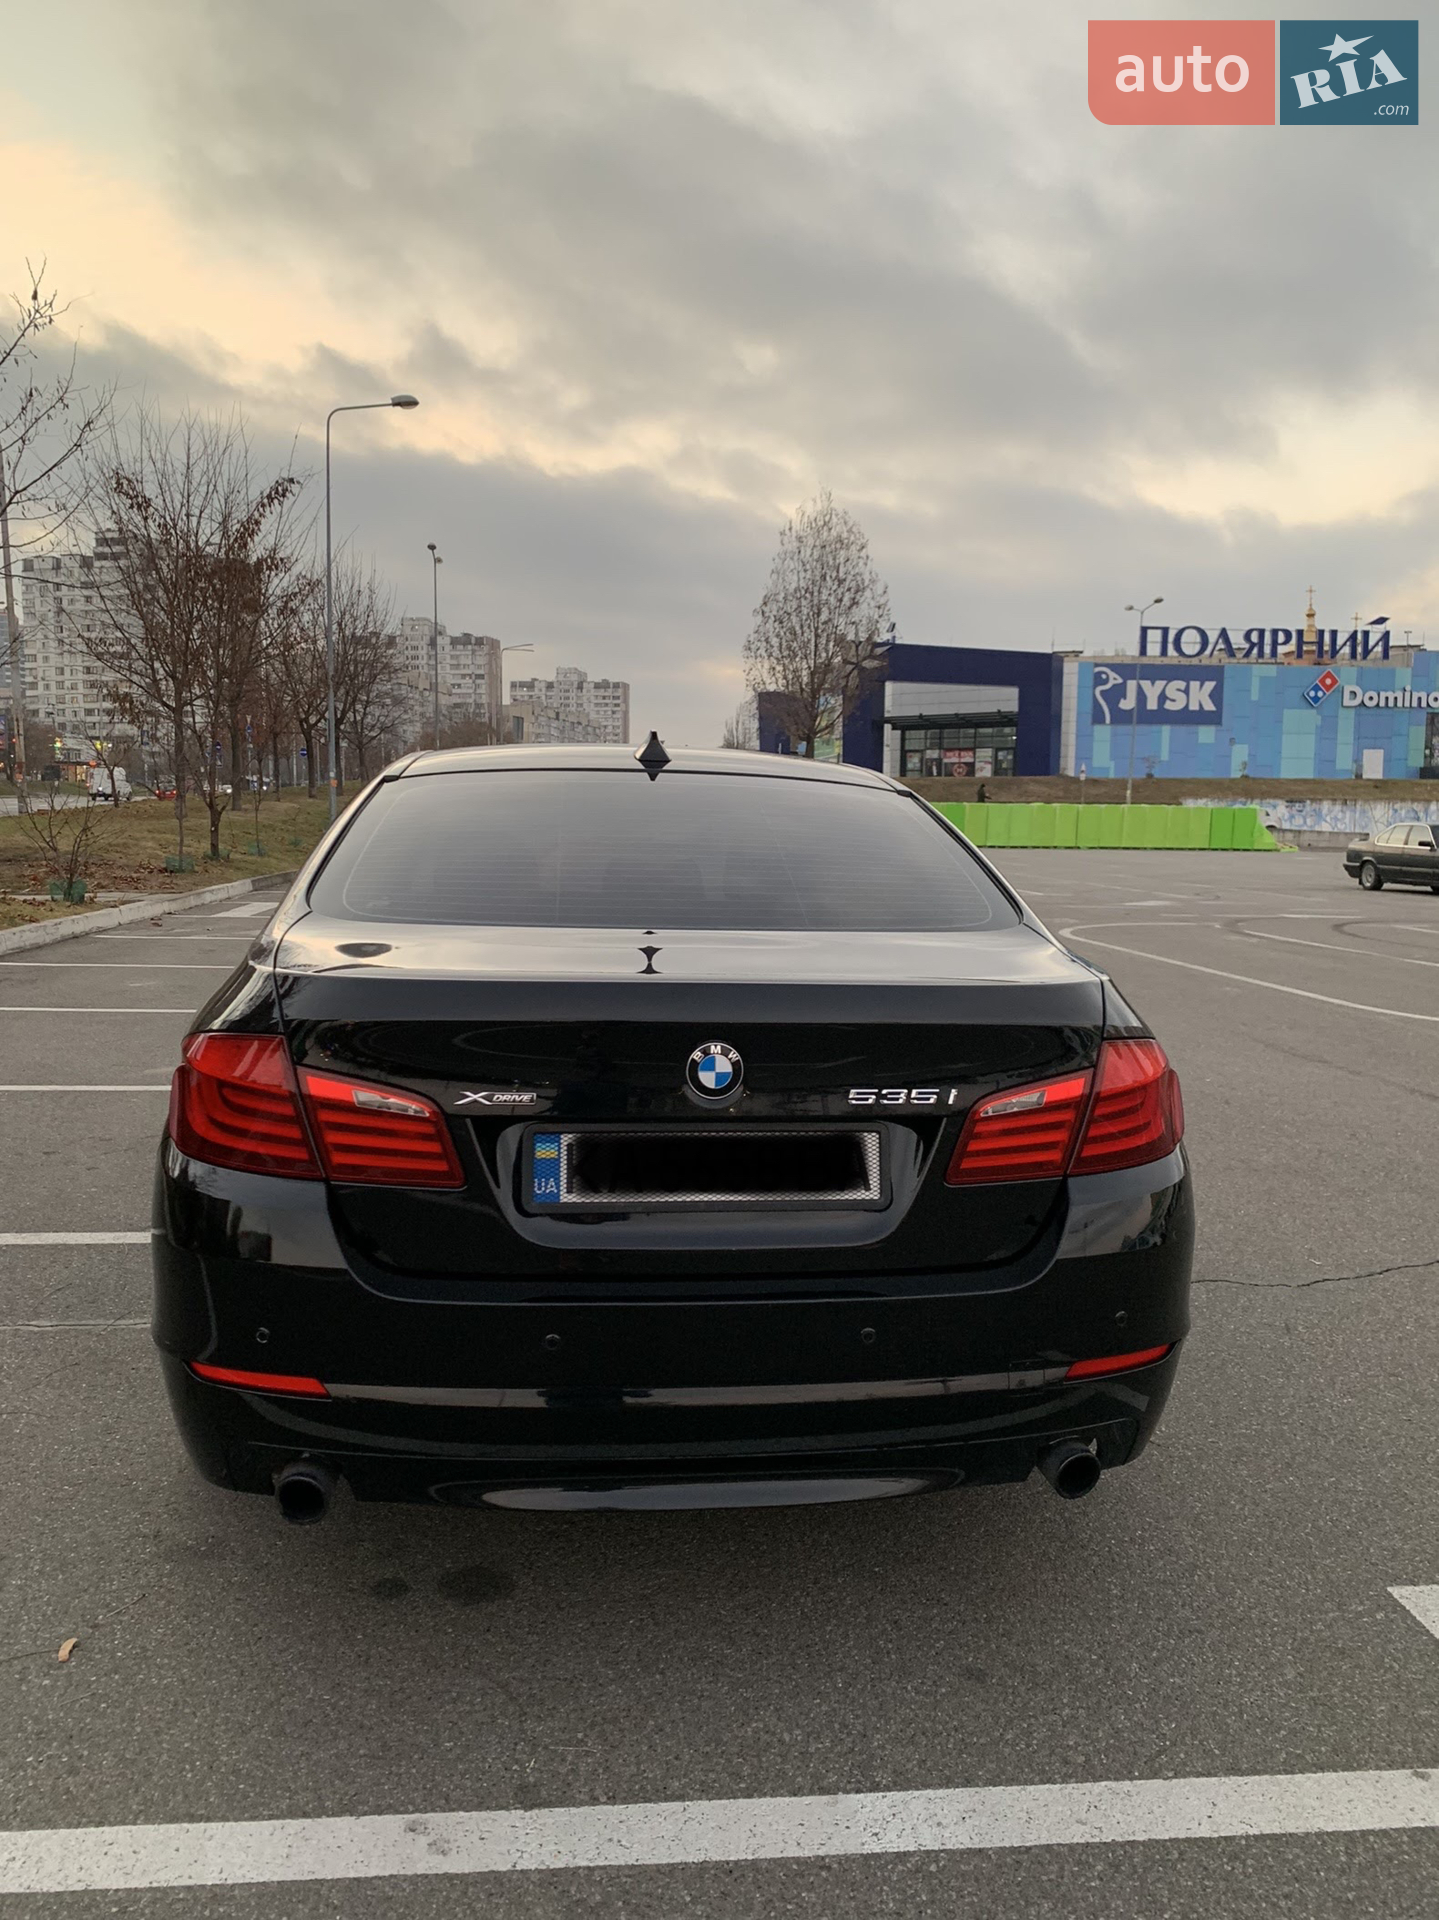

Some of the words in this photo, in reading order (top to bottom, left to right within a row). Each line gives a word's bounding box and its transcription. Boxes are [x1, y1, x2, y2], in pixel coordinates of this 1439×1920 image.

[1139, 616, 1391, 661] ПОЛЯРНИЙ
[1118, 679, 1217, 711] JYSK
[692, 1044, 740, 1063] BMW
[534, 1178, 558, 1194] UA
